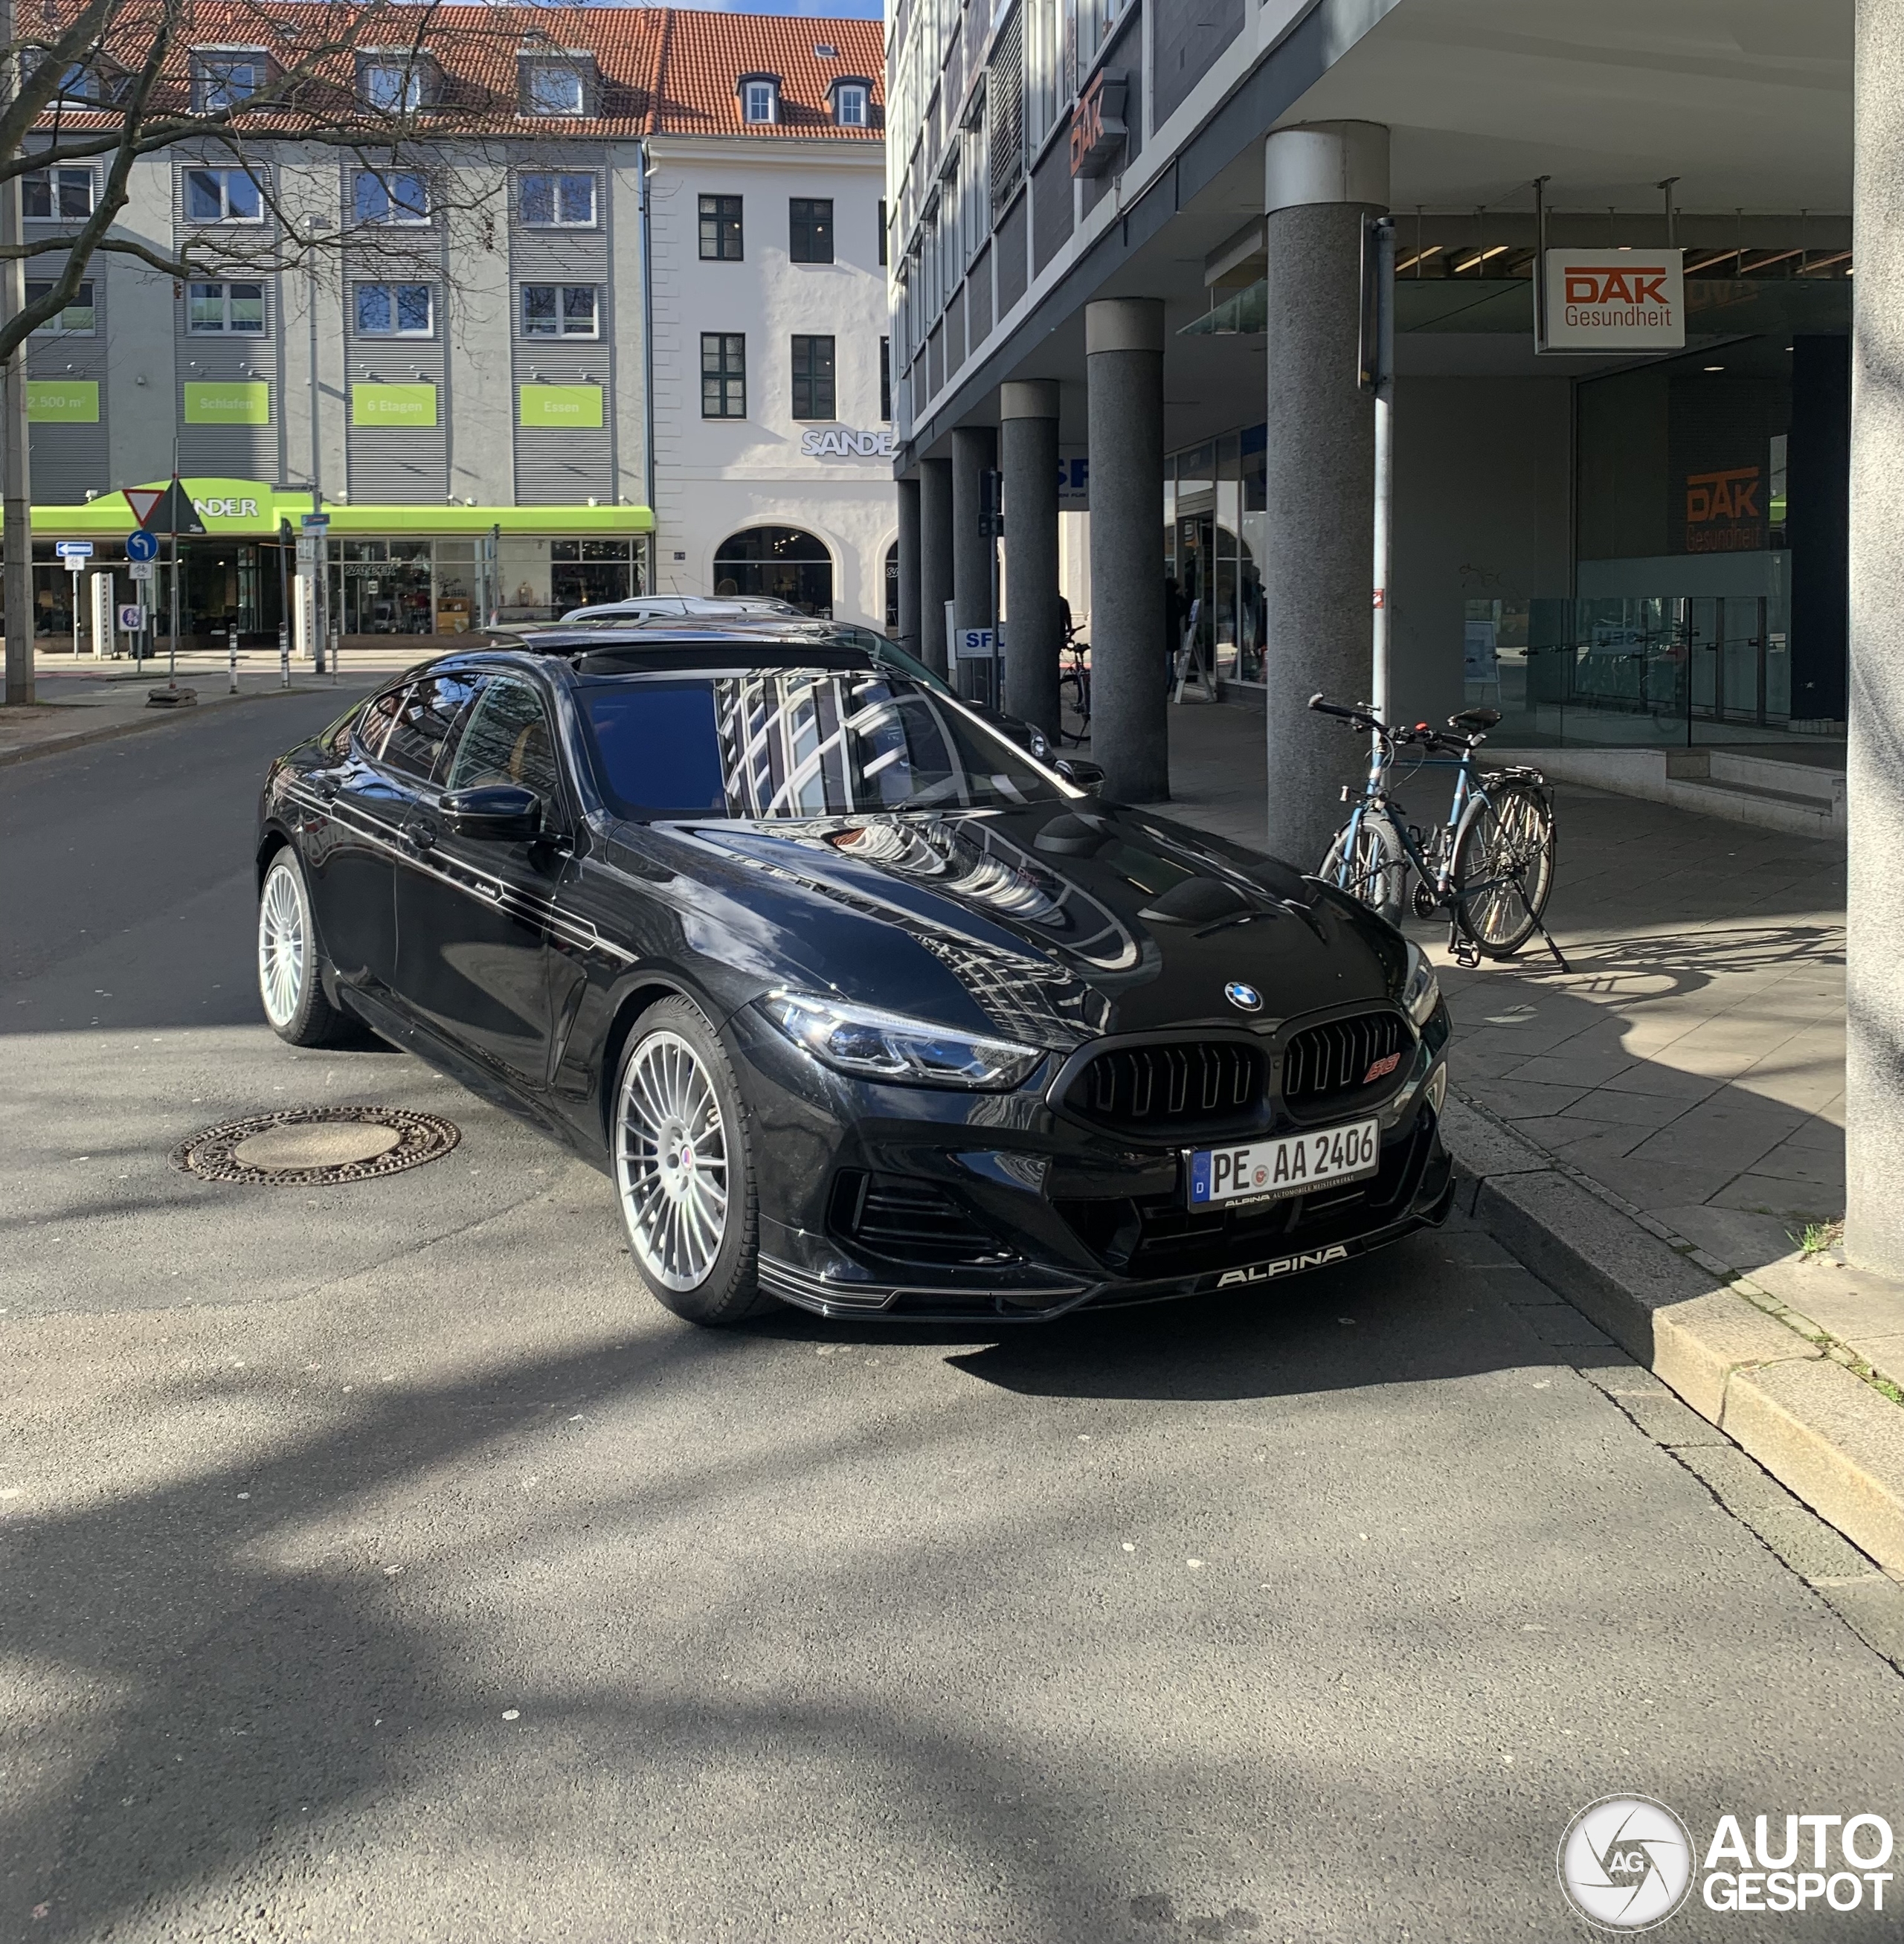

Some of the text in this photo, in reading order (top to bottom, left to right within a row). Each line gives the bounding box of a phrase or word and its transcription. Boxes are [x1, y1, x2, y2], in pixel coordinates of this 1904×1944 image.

[1070, 68, 1104, 178] DAK
[1565, 267, 1670, 304] DAK
[1566, 306, 1672, 326] Gesundheit
[200, 397, 254, 409] Schlafen
[367, 400, 423, 413] 6 Etagen
[544, 402, 579, 413] Essen
[1687, 466, 1760, 521] DAK
[1687, 522, 1762, 552] Gesundheit
[1196, 1125, 1373, 1194] D PE AA 2406
[1225, 1175, 1354, 1208] ALPINA AUTOMOBILE MEISTERWERKE
[1217, 1245, 1348, 1287] ALPINA
